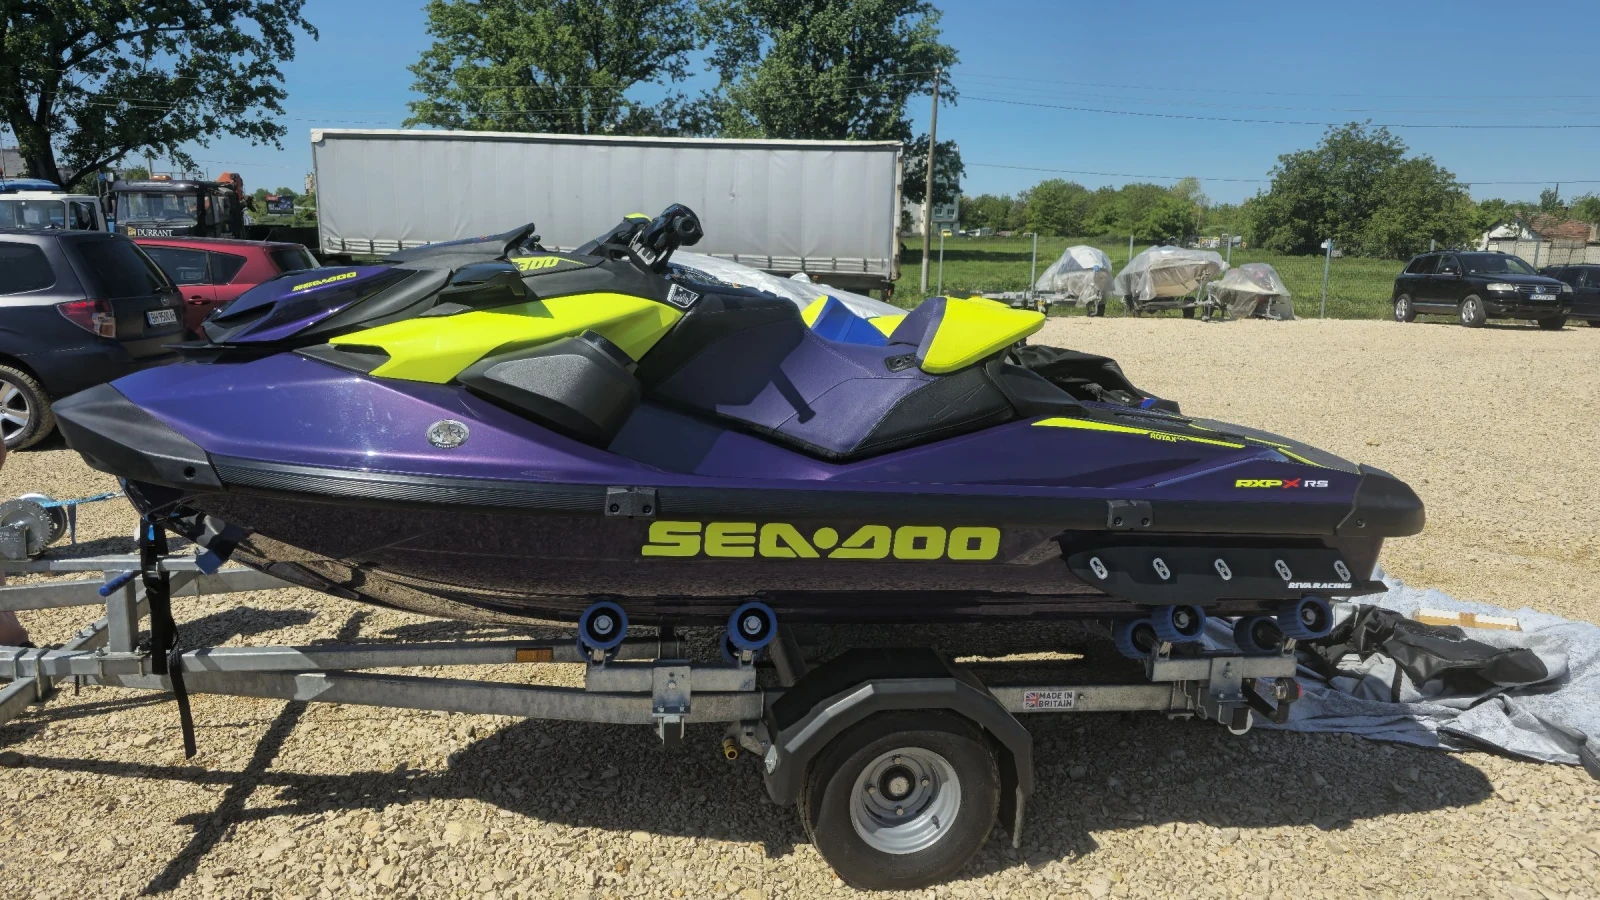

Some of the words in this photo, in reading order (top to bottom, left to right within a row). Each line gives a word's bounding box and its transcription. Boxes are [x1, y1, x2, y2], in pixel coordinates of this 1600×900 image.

[137, 228, 173, 237] DURRANT
[1150, 432, 1177, 443] ROTAX
[1304, 480, 1329, 488] RS
[1287, 581, 1311, 589] RIVA
[1039, 692, 1062, 700] MADE
[1038, 700, 1072, 708] BRITAIN
